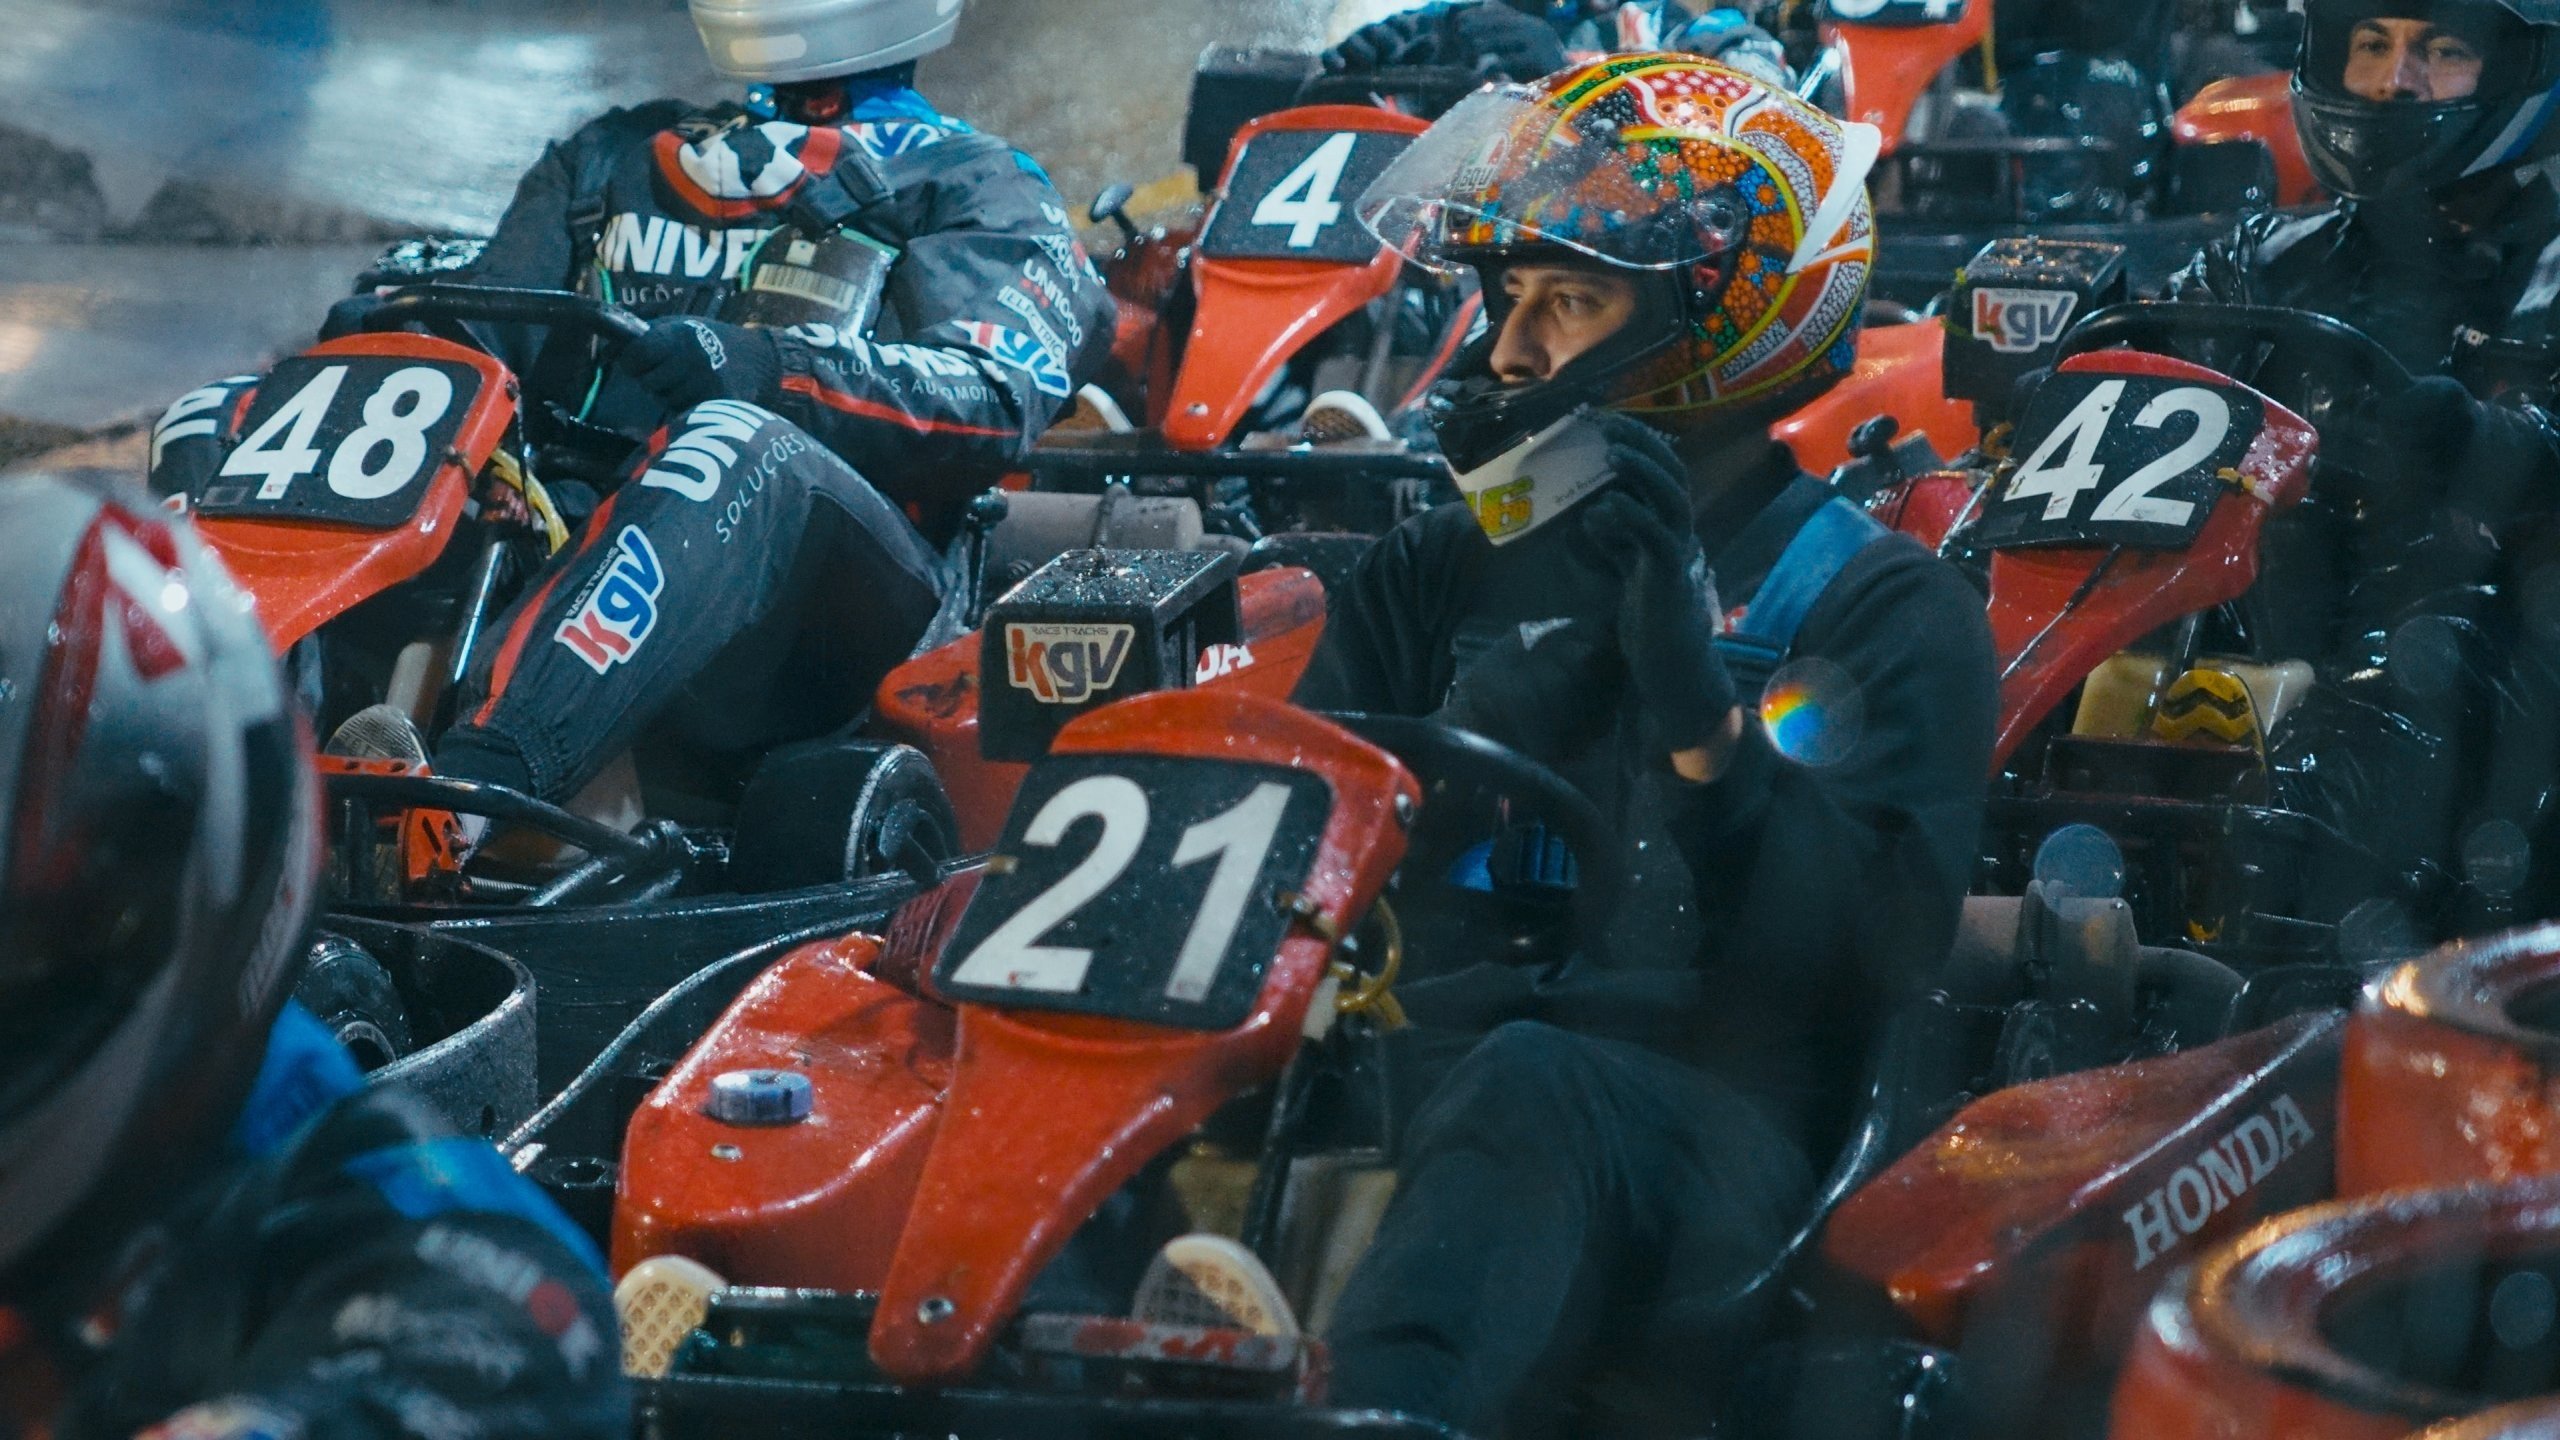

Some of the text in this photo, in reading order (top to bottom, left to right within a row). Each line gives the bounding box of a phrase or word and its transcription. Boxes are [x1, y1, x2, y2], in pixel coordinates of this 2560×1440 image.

[1251, 132, 1357, 248] 4
[1976, 290, 2075, 348] kgv
[219, 365, 453, 500] 48
[715, 431, 806, 544] SOLUÇÕES
[2003, 379, 2230, 526] 42
[558, 527, 662, 670] kgv
[1031, 626, 1062, 636] RACE
[1011, 627, 1131, 699] kgv
[951, 774, 1292, 1003] 21
[2121, 1093, 2316, 1272] HONDA
